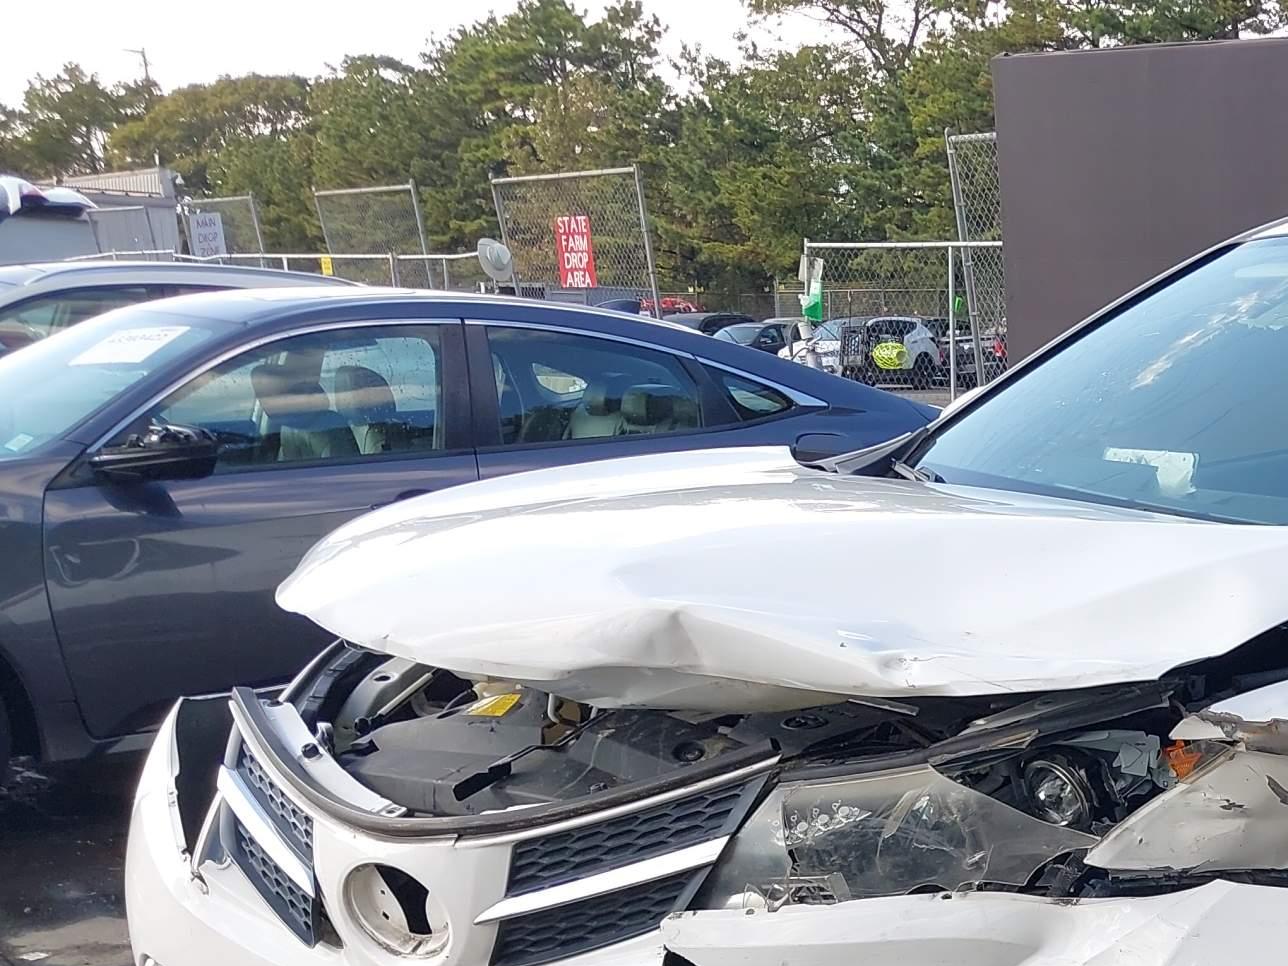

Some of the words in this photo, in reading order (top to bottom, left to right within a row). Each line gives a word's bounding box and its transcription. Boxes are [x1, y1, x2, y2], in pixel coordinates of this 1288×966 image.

[196, 216, 216, 228] MAIN
[557, 215, 588, 233] STATE
[561, 234, 588, 252] FARM
[563, 252, 589, 269] DROP
[566, 271, 593, 288] AREA
